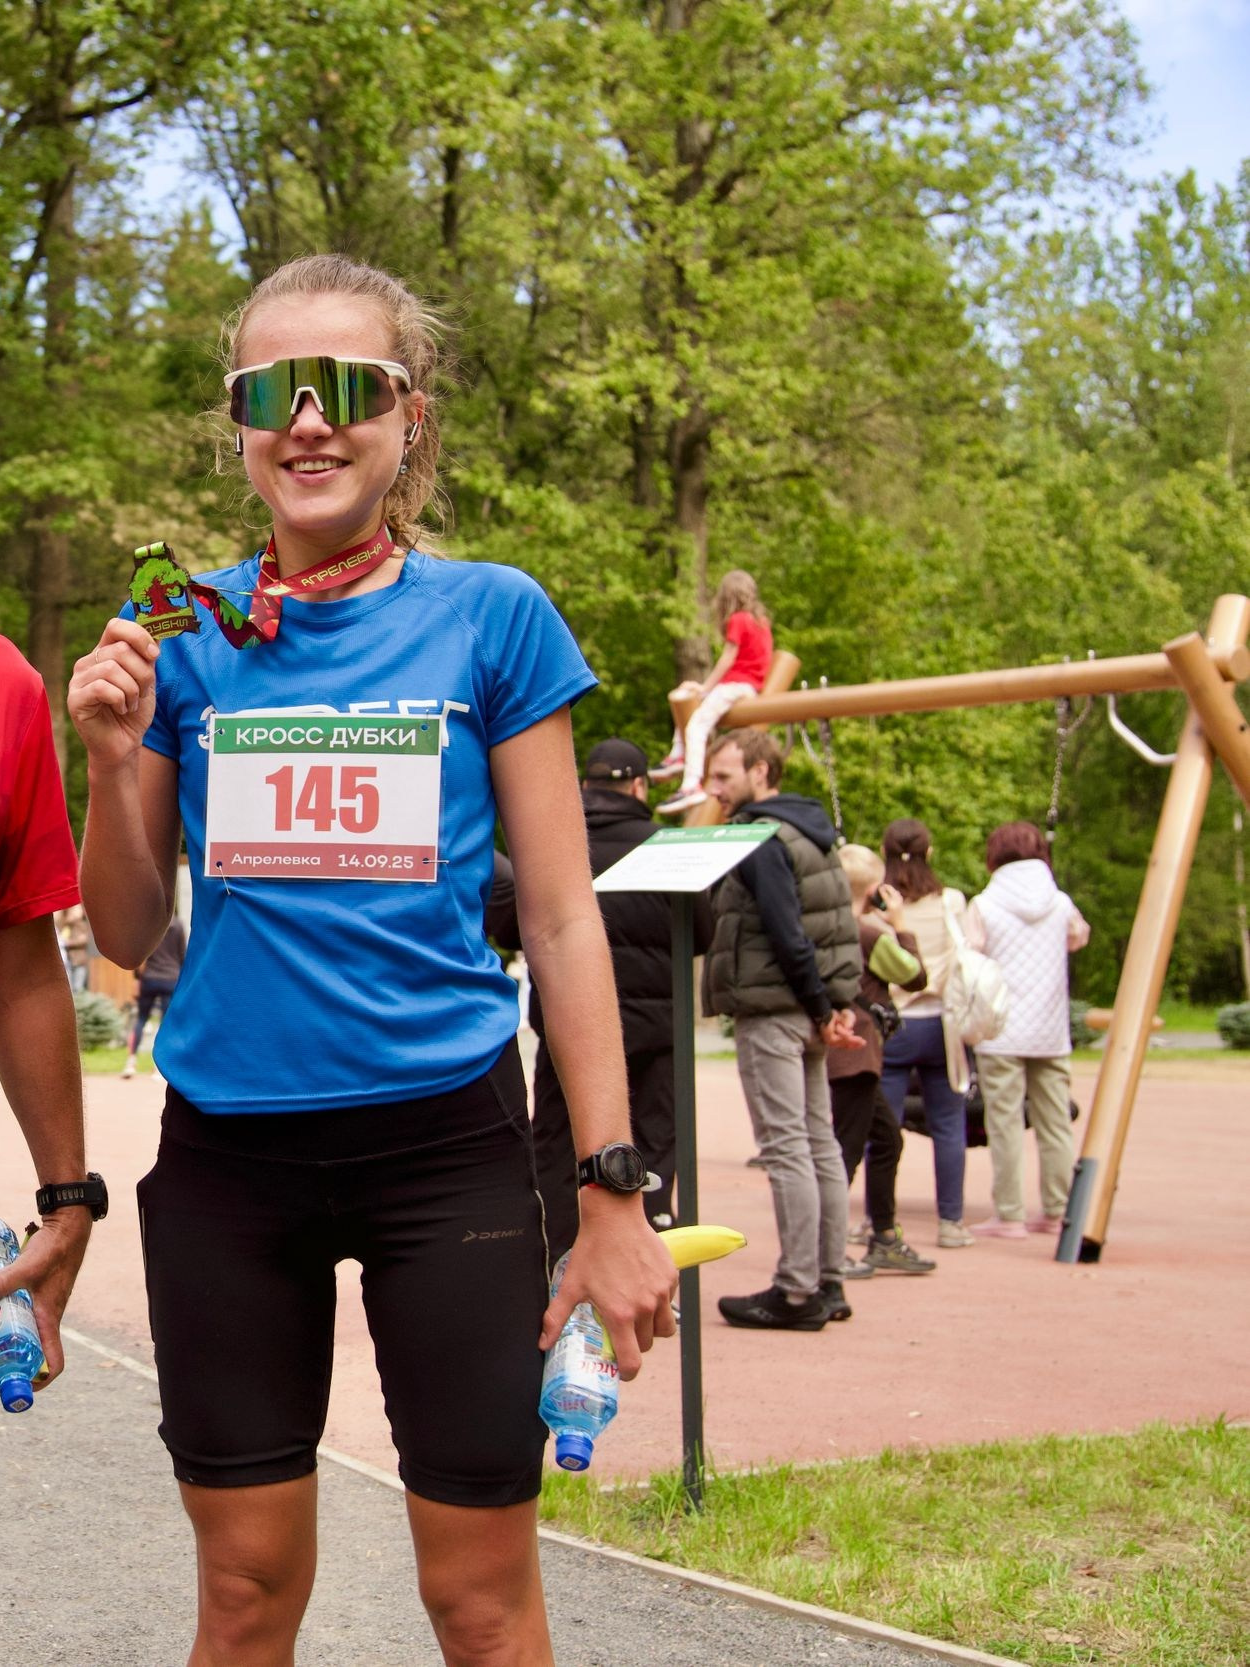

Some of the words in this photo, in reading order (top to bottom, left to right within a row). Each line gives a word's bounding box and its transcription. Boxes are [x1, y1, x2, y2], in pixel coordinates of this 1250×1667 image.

[301, 542, 383, 587] АПРЕЛЕВКА
[236, 726, 323, 745] КРОСС
[329, 727, 416, 748] ДУБКИ
[265, 765, 380, 834] 145
[231, 852, 321, 867] Апрелевка
[338, 854, 414, 869] 14.09.25
[478, 1228, 526, 1239] DEMIX
